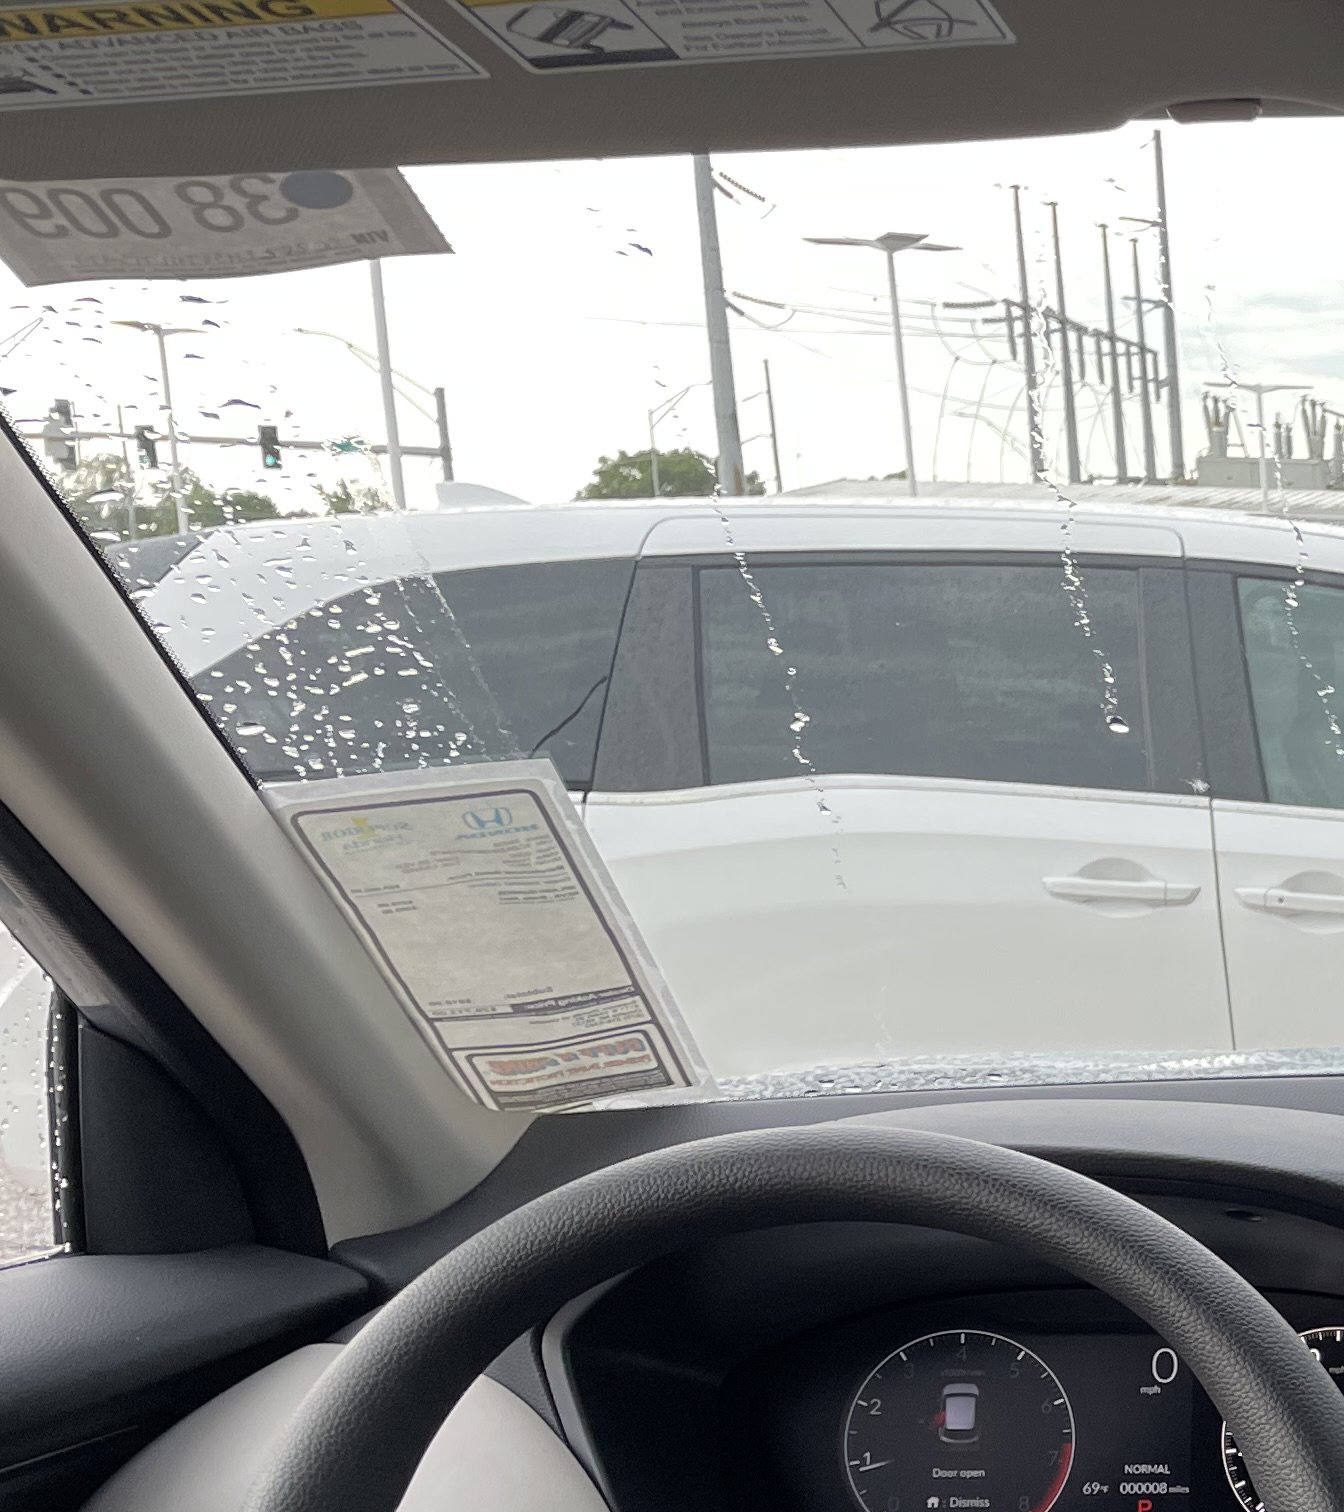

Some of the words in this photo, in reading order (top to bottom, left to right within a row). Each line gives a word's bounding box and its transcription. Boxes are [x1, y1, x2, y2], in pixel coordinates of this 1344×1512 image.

[1151, 1347, 1178, 1383] 0
[869, 1399, 882, 1415] 2
[863, 1452, 871, 1464] 1
[932, 1468, 958, 1478] Door
[960, 1469, 985, 1479] open
[1124, 1464, 1171, 1474] NORMAL
[1120, 1482, 1168, 1494] 000008
[949, 1497, 990, 1508] Dismiss
